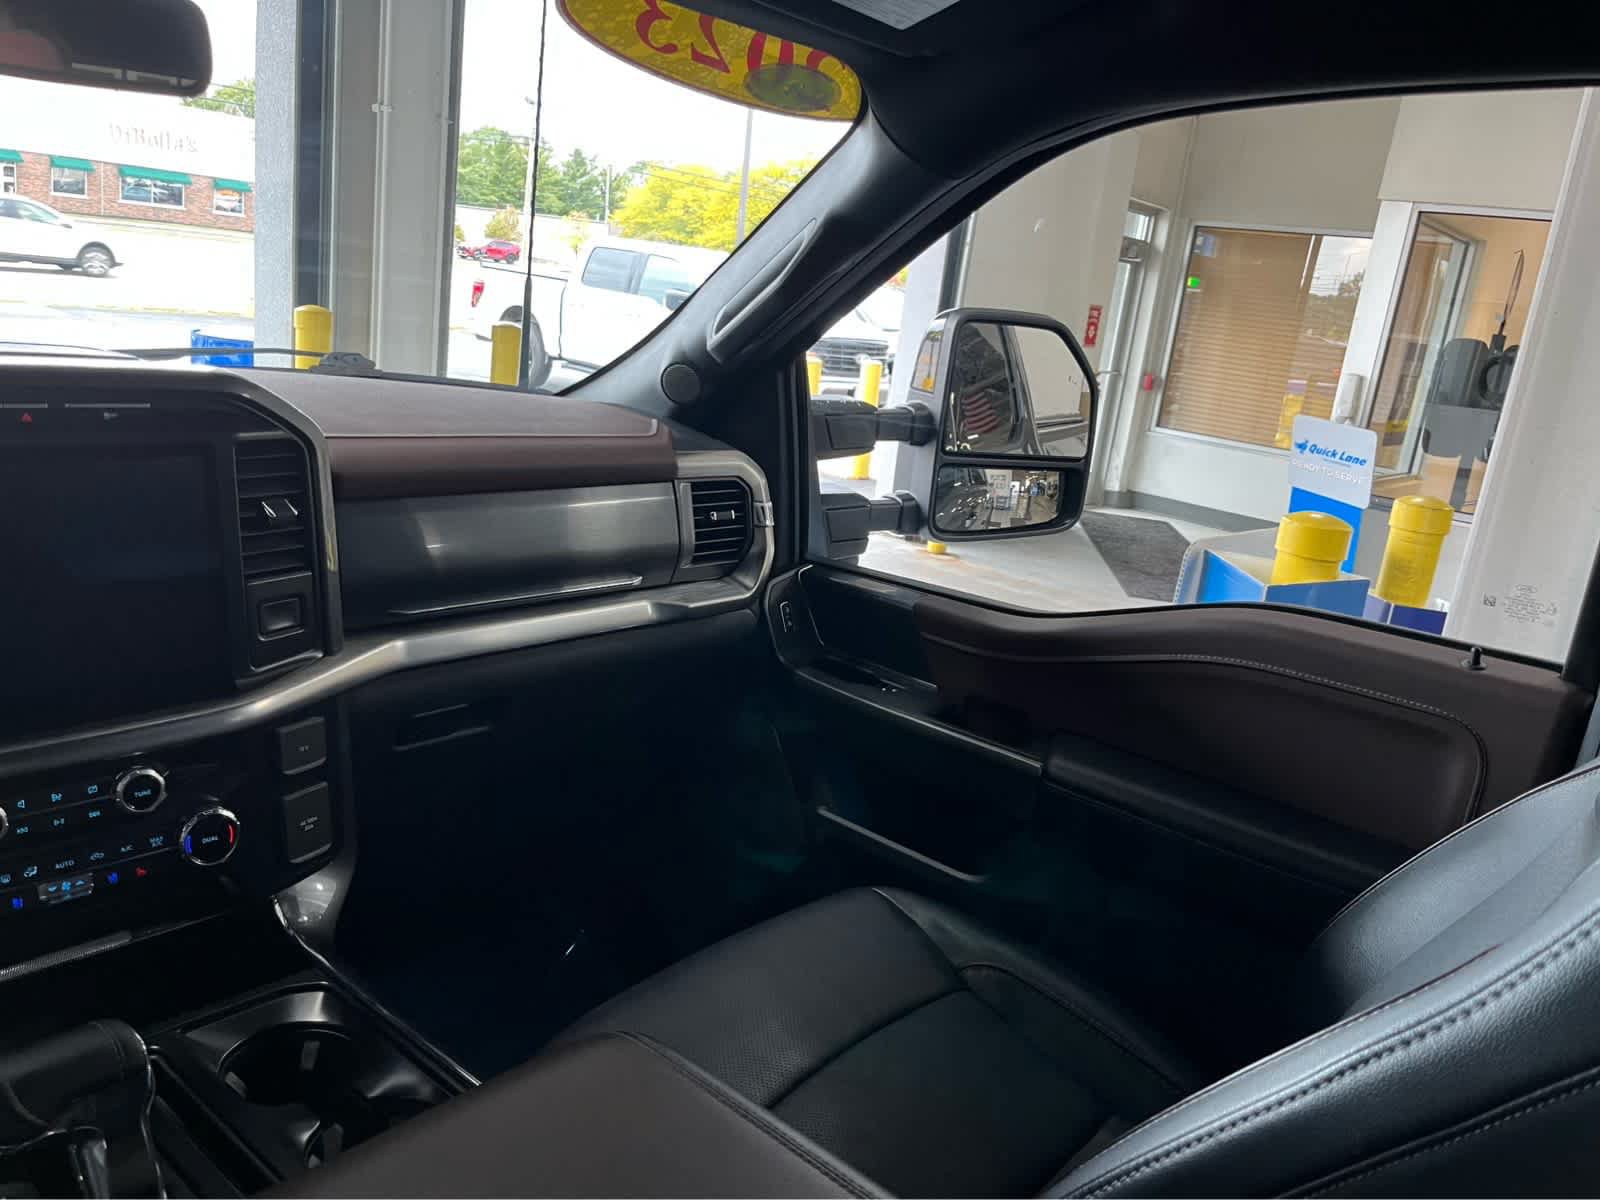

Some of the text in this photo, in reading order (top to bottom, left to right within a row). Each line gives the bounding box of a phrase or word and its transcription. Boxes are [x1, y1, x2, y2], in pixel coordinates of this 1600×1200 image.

[1308, 443, 1338, 459] Quick
[1339, 451, 1367, 466] Lane
[55, 859, 75, 870] AUTO
